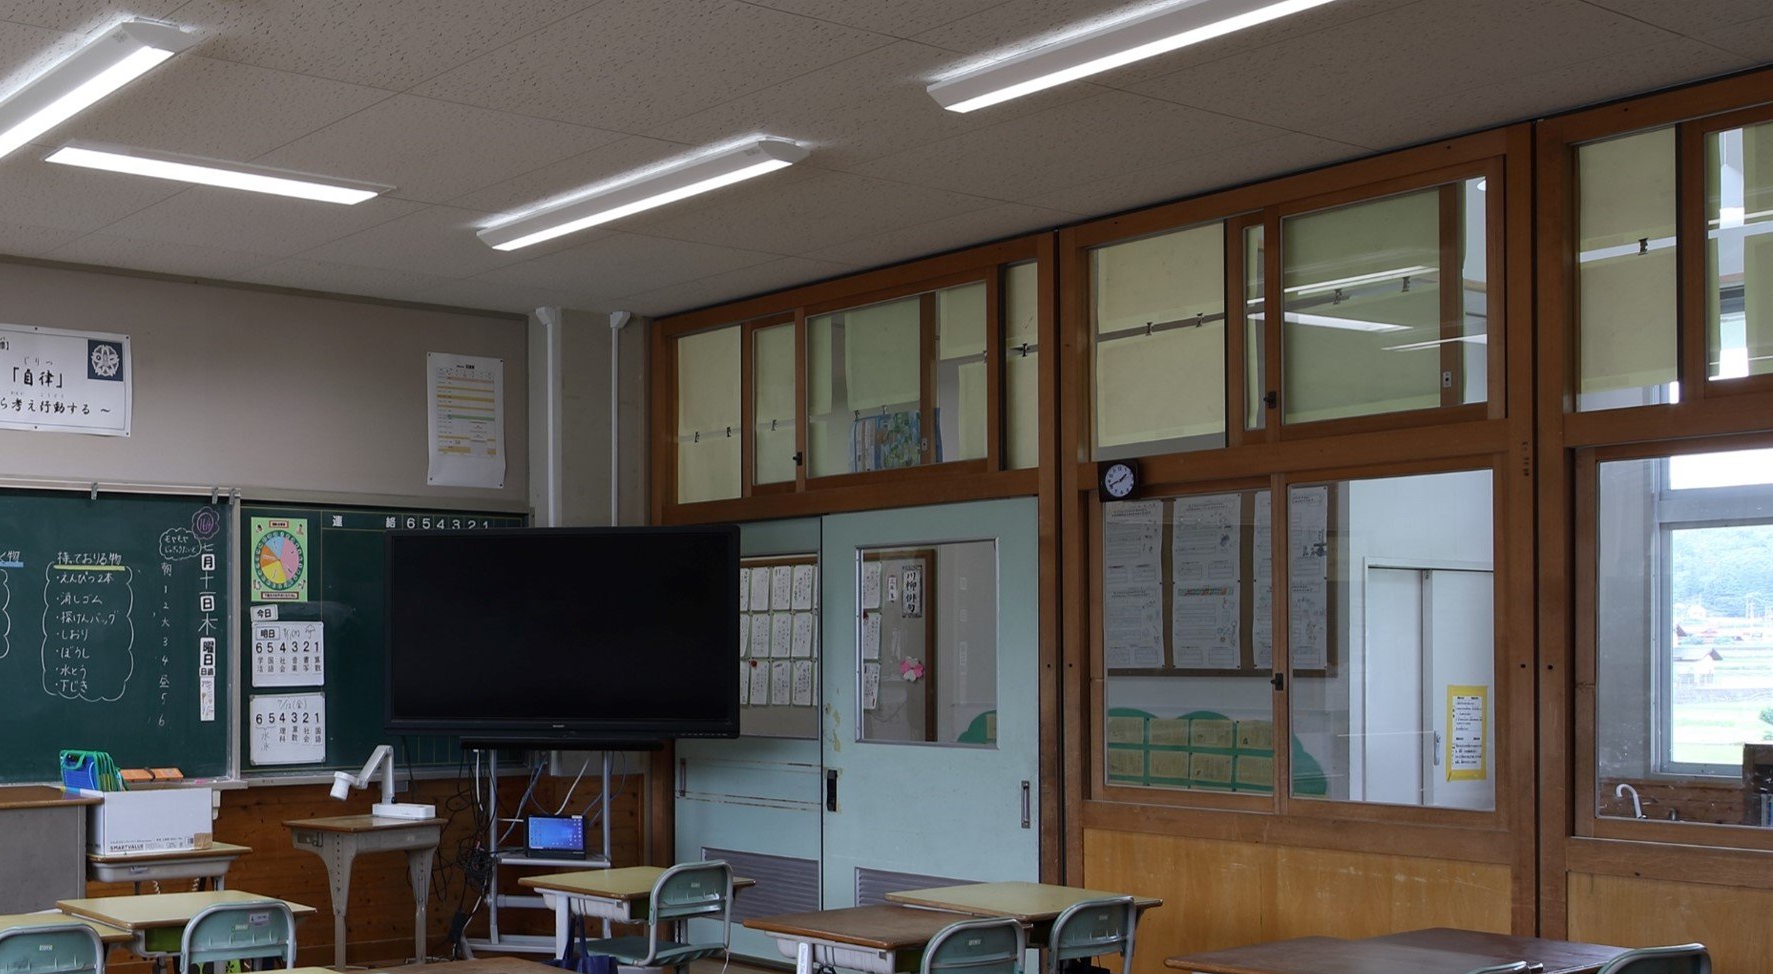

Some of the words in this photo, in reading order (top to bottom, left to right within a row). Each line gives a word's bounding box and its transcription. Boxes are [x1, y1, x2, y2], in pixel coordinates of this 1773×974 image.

[23, 356, 53, 366] じりつ
[13, 367, 63, 388] 「自律」
[406, 518, 416, 529] 6
[422, 518, 431, 529] 5
[436, 518, 445, 529] 4
[57, 551, 122, 565] 持っておりる物
[60, 571, 114, 584] えんぴつ2本
[60, 592, 103, 605] 消しゴム
[163, 601, 169, 610] 2
[256, 608, 272, 618] 今日
[61, 629, 88, 641] しおり
[260, 628, 276, 638] 明日
[162, 637, 168, 647] 3
[255, 642, 263, 653] 6
[267, 642, 274, 653] 5
[279, 641, 287, 653] 4
[291, 641, 298, 652] 3
[303, 641, 310, 652] 2
[314, 641, 319, 651] 1
[60, 645, 90, 659] ぼうし
[161, 655, 168, 665] 4
[59, 664, 87, 680] 水とう
[60, 679, 88, 693] 下じき
[158, 714, 165, 726] 6
[255, 713, 263, 725] 6
[268, 713, 275, 724] 5
[279, 713, 286, 723] 4
[291, 713, 298, 723] 3
[302, 712, 309, 723] 2
[314, 712, 319, 723] 1
